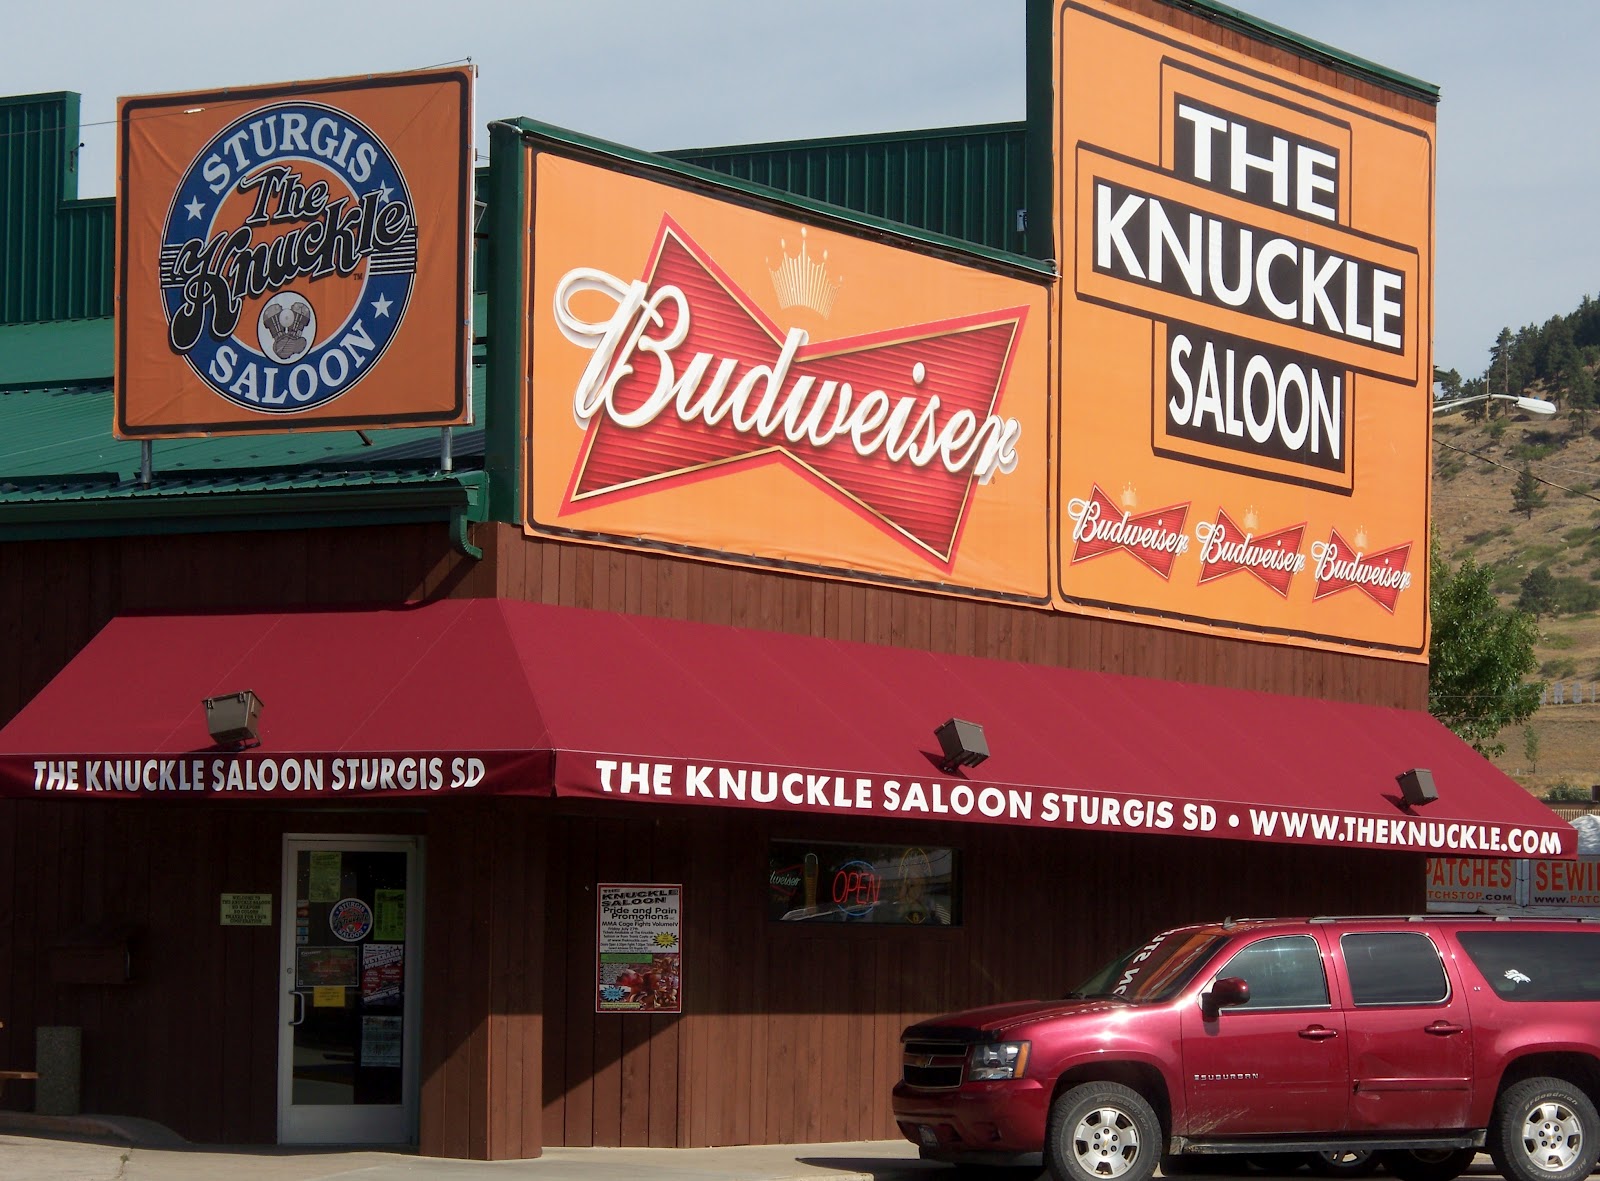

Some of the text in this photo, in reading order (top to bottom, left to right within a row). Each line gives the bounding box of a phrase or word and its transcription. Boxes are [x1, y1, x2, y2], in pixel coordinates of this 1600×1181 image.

[203, 113, 378, 195] STURGIS
[1178, 103, 1336, 221] THE
[238, 166, 330, 226] The
[170, 190, 411, 353] Knuckle
[1097, 184, 1402, 349] KNUCKLE
[209, 318, 377, 405] SALOON
[553, 267, 1021, 485] Budweiser
[1168, 334, 1341, 460] SALOON
[1068, 498, 1189, 556] Budweiser
[1195, 521, 1305, 575] Budweiser
[1311, 541, 1411, 591] Budweiser
[34, 757, 486, 791] THE KNUCKLE SALOON STURGIS SD
[595, 759, 1562, 855] THE KNUCKLE SALOON STURGIS SD WWW.THEKNUCKLE.COM
[602, 889, 679, 900] KNUCKLE
[832, 870, 882, 905] OPEN
[1426, 857, 1512, 888] PATCHES
[338, 902, 366, 912] STURGIS
[601, 897, 667, 907] SALOON
[338, 929, 364, 939] SALOON
